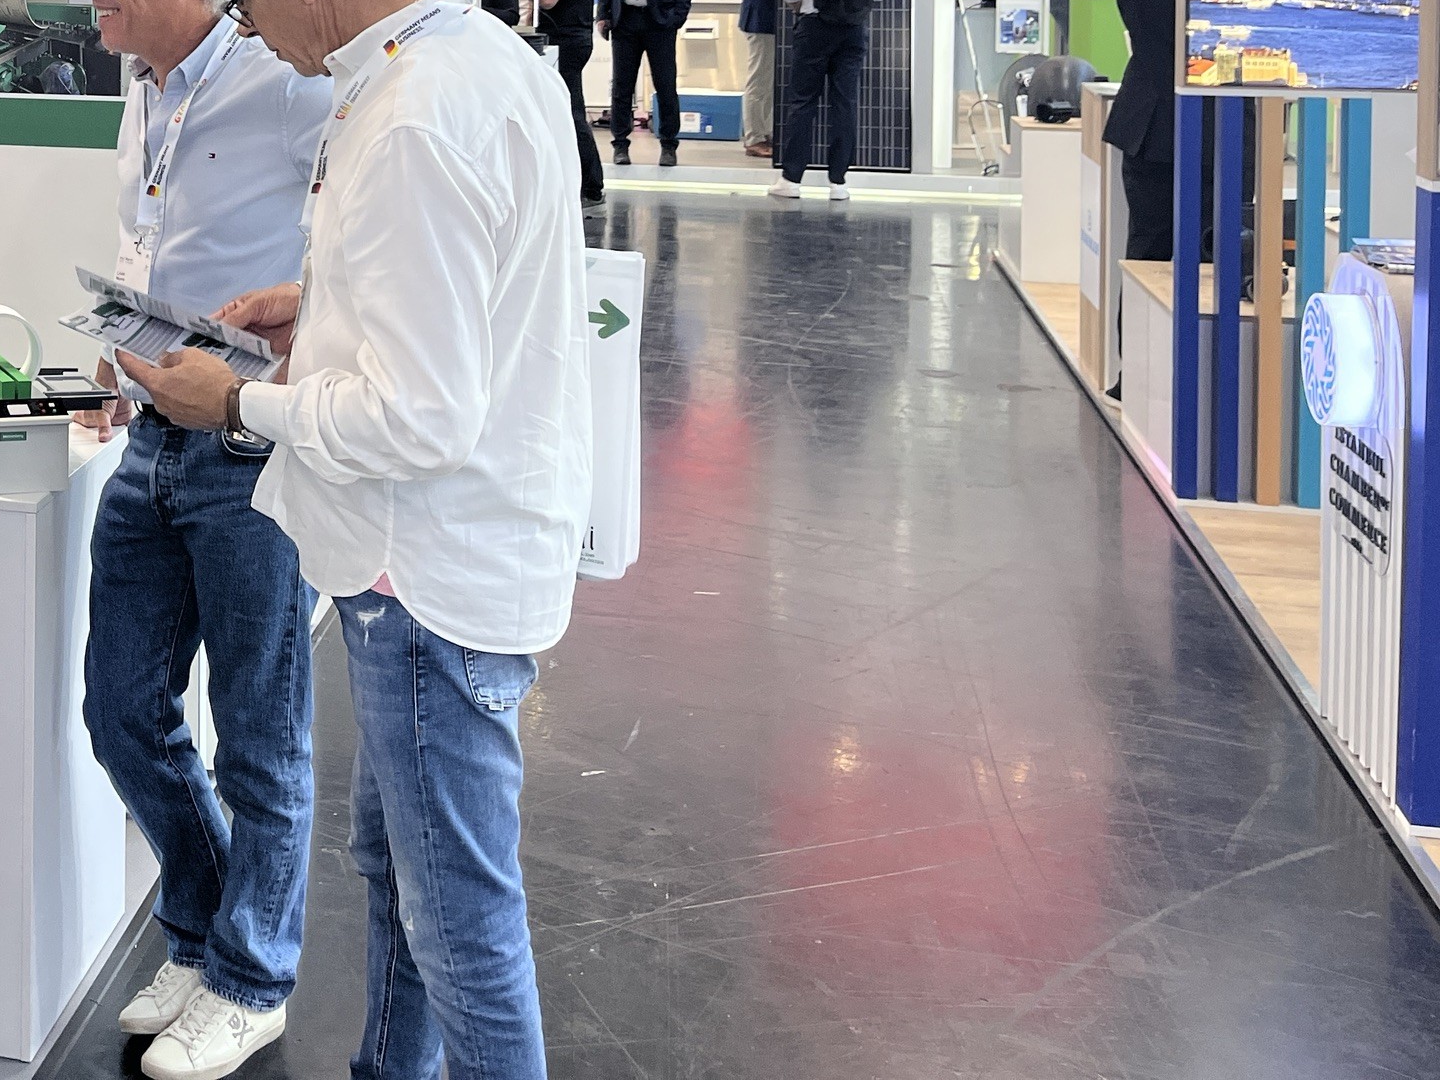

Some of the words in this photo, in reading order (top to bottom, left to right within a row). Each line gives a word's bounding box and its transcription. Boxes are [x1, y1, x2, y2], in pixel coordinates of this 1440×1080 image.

[395, 20, 421, 41] GERMANY
[421, 8, 441, 25] MEANS
[1335, 427, 1386, 478] ISTANBUL
[1330, 453, 1382, 512] CHAMBER
[1329, 487, 1388, 554] COMMERCE
